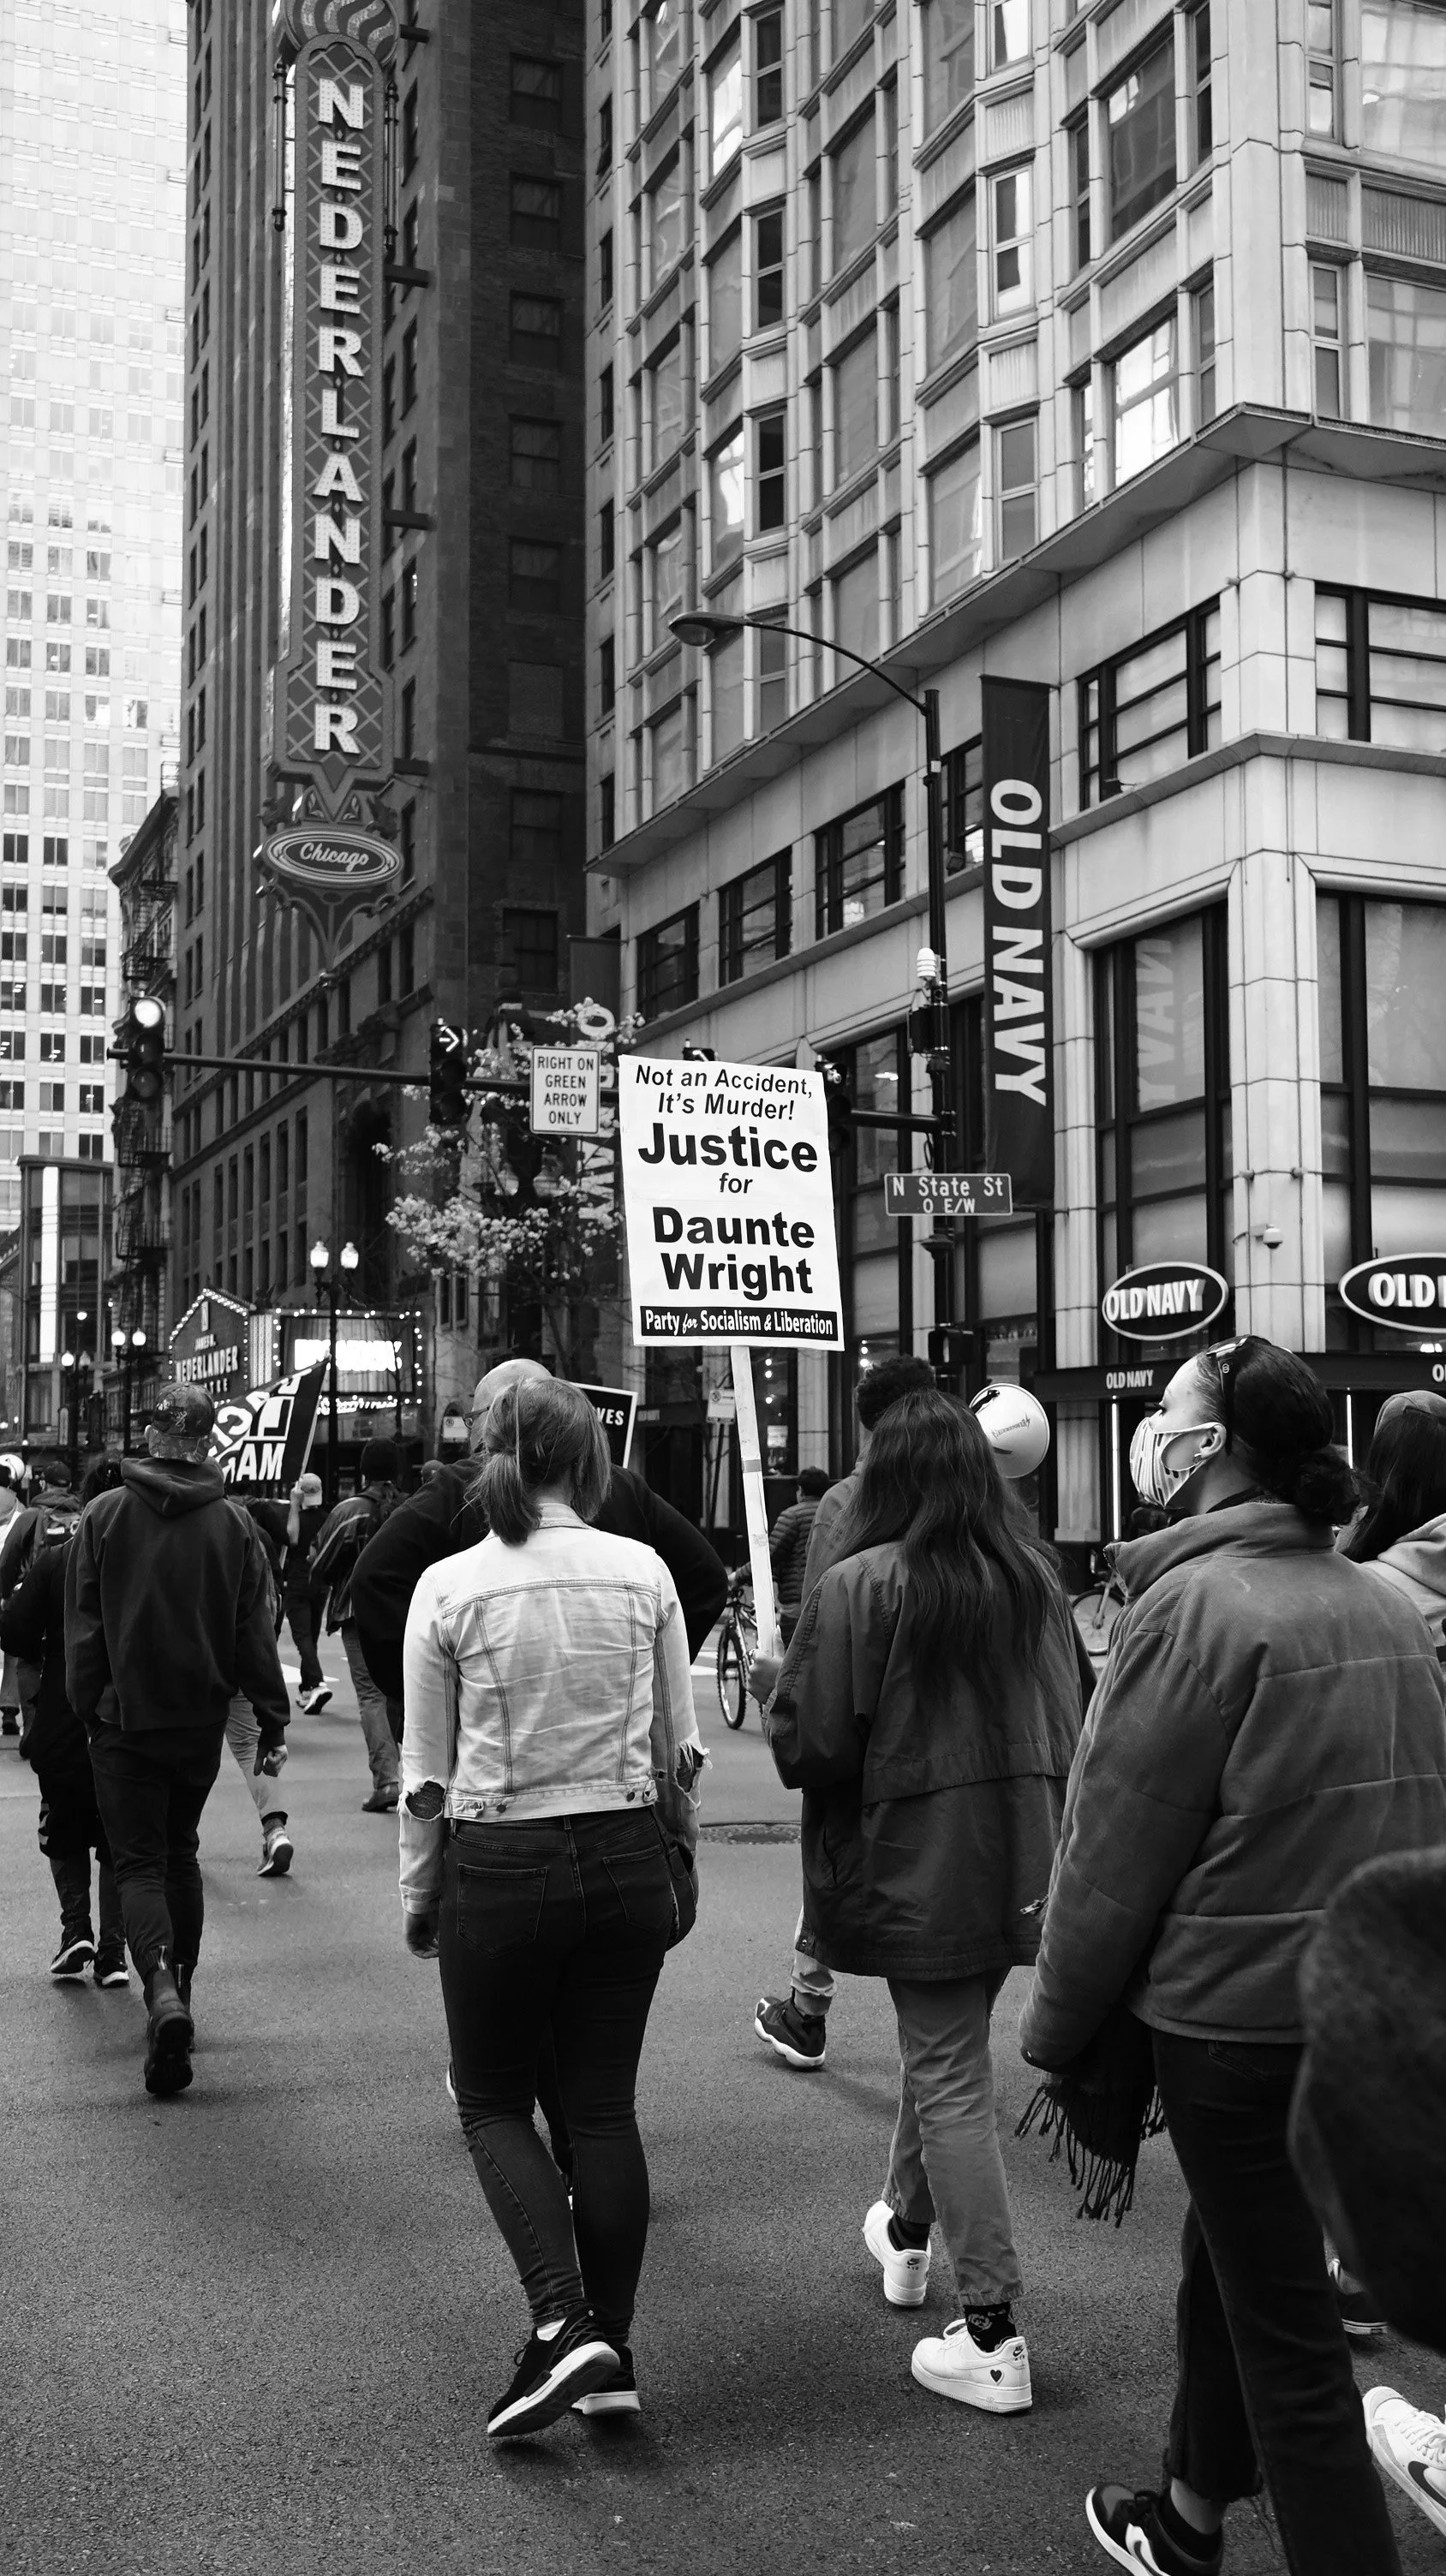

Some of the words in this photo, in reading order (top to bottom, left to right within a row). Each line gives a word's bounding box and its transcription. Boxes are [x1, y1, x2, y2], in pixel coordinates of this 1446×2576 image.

[313, 78, 364, 754] NEDERLANDER
[990, 778, 1043, 909] OLD
[300, 843, 370, 873] Chicago
[992, 926, 1047, 1106] NAVY
[537, 1056, 573, 1070] RIGHT
[577, 1058, 594, 1070] ON
[545, 1074, 586, 1088] GREEN
[636, 1064, 673, 1087] Not
[681, 1071, 708, 1087] an
[714, 1069, 812, 1098] Accident,
[543, 1093, 587, 1106] ARROW
[658, 1093, 695, 1114] It's
[705, 1094, 794, 1120] Murder!
[548, 1111, 581, 1124] ONLY
[638, 1122, 817, 1172] Justice
[720, 1172, 753, 1194] for
[893, 1177, 905, 1196] N
[917, 1176, 971, 1196] State
[983, 1177, 1003, 1196] St
[944, 1198, 975, 1213] E/W
[653, 1207, 815, 1248] Daunte
[660, 1253, 813, 1301] Wright
[1368, 1273, 1436, 1308] OLD
[1106, 1287, 1144, 1321] OLD
[1146, 1278, 1204, 1317] NAVY
[645, 1309, 679, 1336] Party
[683, 1313, 698, 1333] for
[701, 1309, 762, 1331] Socialism
[763, 1314, 772, 1331] &
[774, 1311, 834, 1335] Liberation
[1106, 1372, 1126, 1389] OLD
[1126, 1369, 1154, 1387] NAVY
